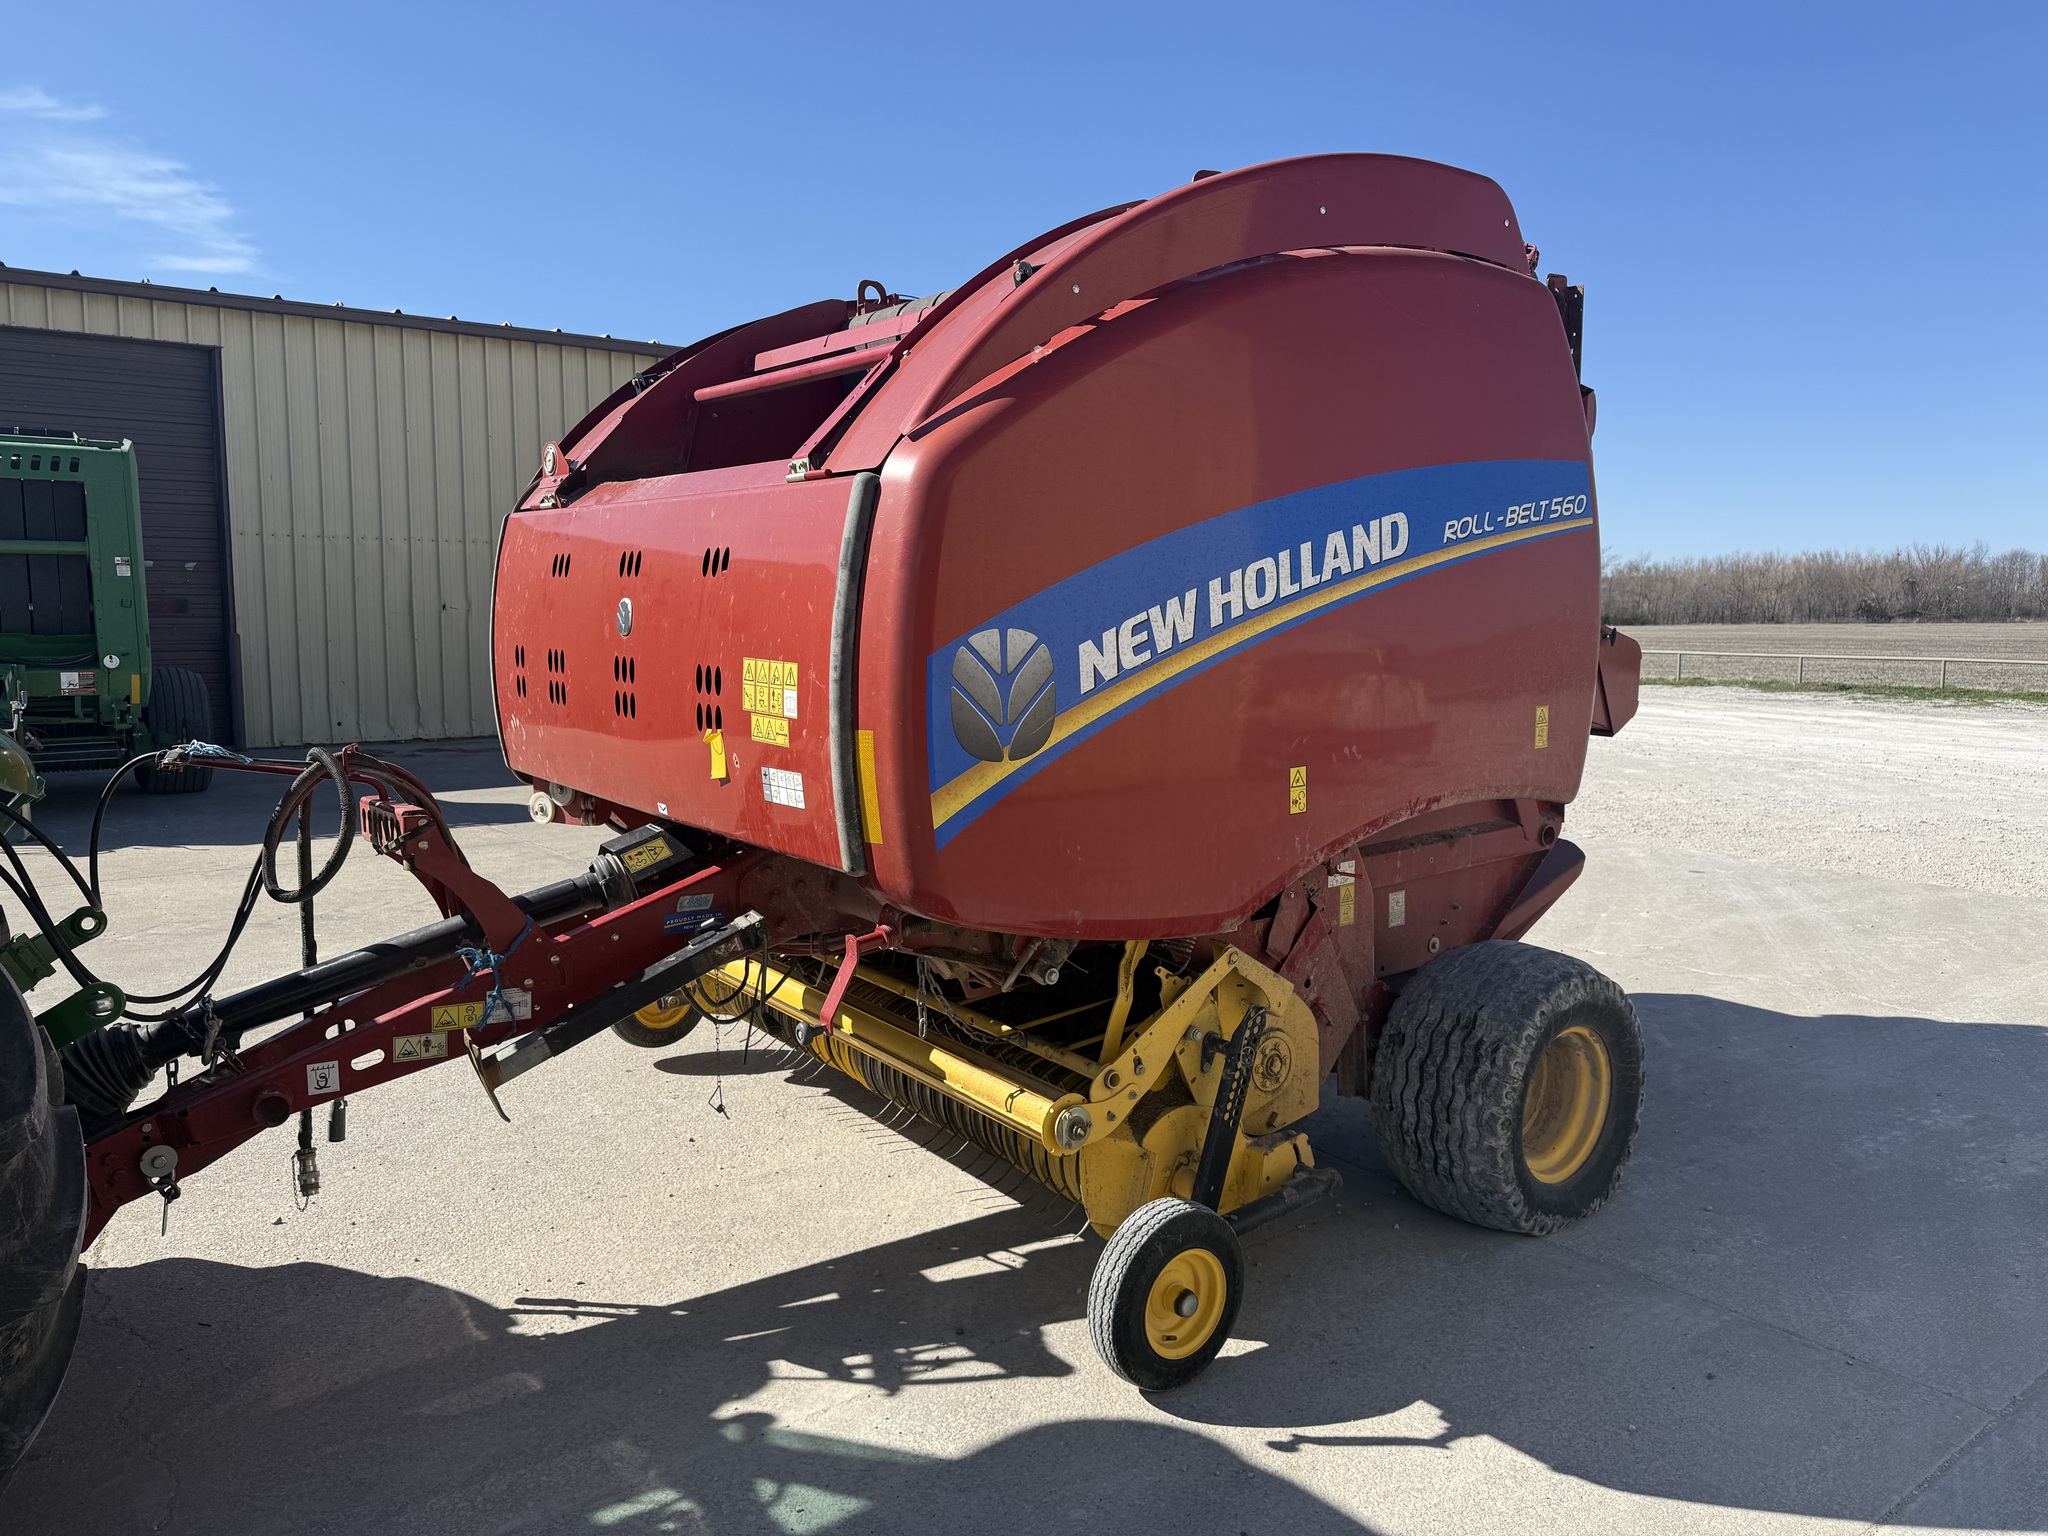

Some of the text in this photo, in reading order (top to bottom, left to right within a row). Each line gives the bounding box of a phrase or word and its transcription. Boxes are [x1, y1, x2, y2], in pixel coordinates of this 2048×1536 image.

[1078, 511, 1410, 695] NEW HOLLAND
[666, 915, 695, 925] PROUDLY
